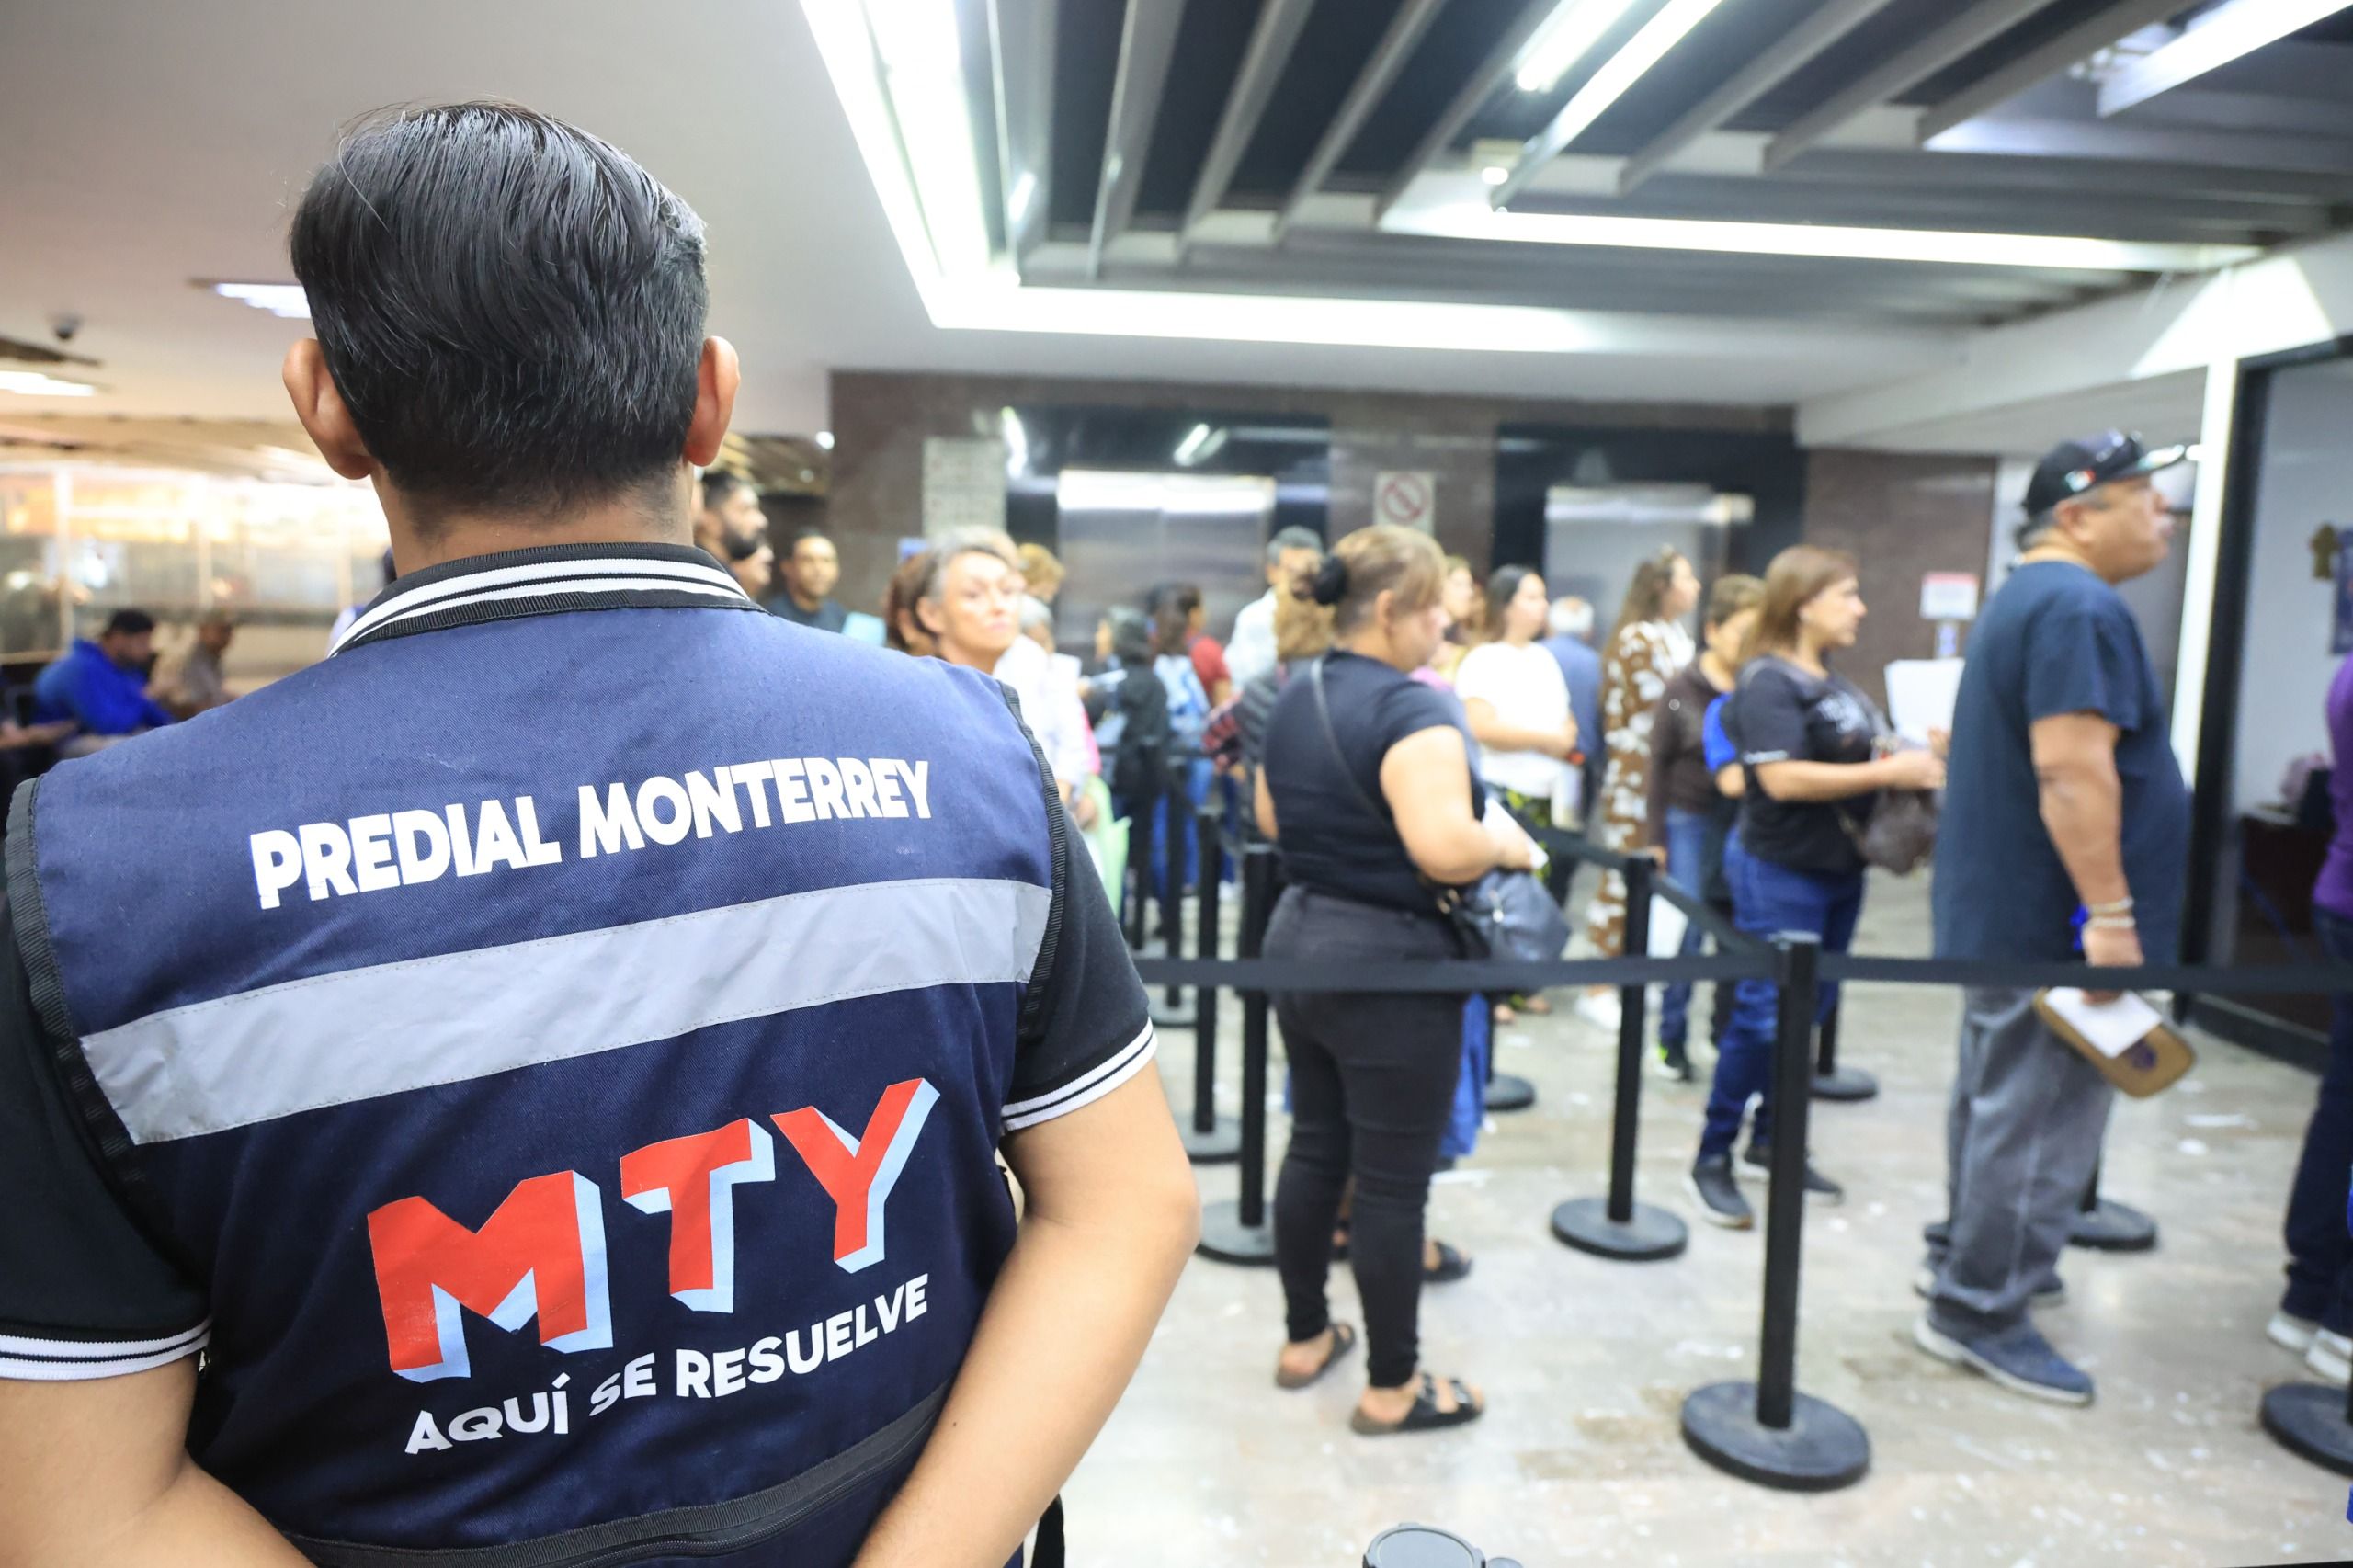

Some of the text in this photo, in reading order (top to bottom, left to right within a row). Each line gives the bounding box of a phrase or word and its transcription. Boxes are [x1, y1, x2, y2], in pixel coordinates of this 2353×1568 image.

[250, 757, 931, 909] PREDIAL MONTERREY
[368, 1078, 940, 1382] MTY
[405, 1273, 928, 1454] AQUÍ SE RESUELVE
